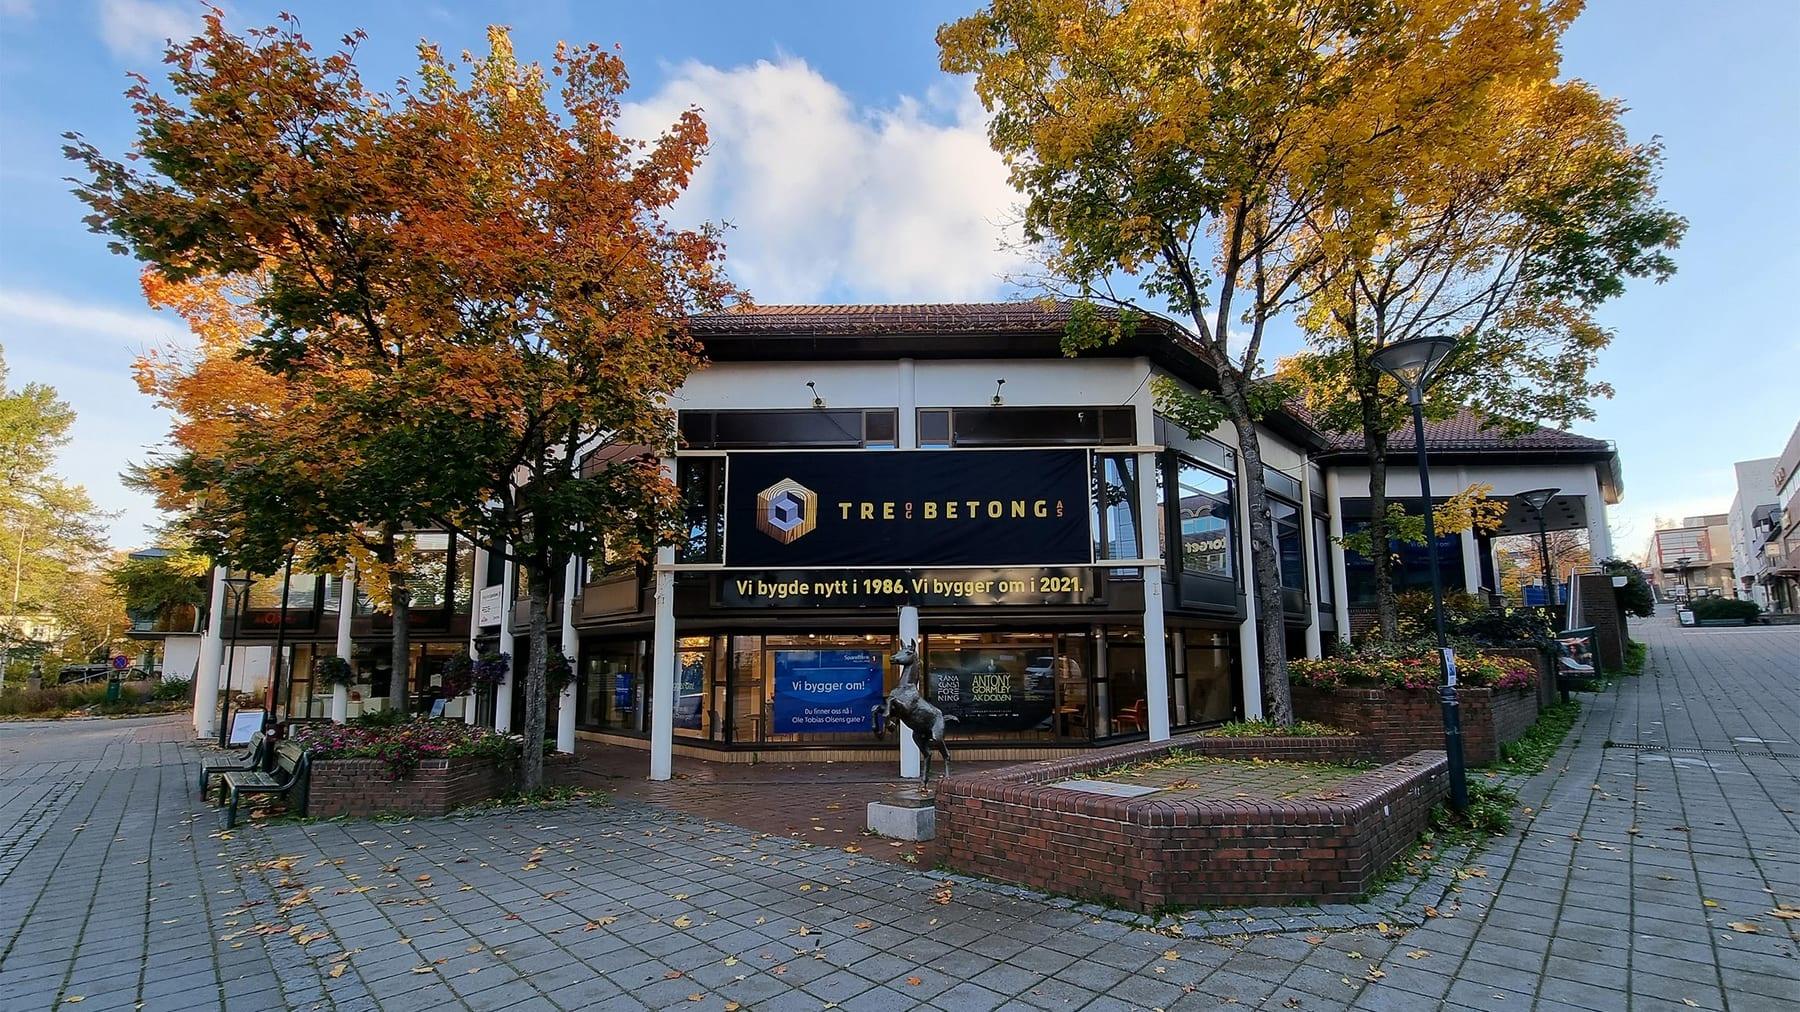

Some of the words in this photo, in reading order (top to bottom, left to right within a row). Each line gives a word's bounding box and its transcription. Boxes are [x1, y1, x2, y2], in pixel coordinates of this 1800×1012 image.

[838, 502, 895, 520] TRE
[905, 502, 913, 519] OG
[924, 500, 1047, 519] BETONG
[1056, 500, 1064, 517] AS
[736, 580, 752, 595] Vi
[757, 580, 810, 599] bygde
[814, 580, 848, 598] nytt
[853, 579, 857, 594] i
[863, 578, 909, 594] 1986.
[912, 578, 928, 593] Vi
[933, 578, 994, 597] bygger
[998, 580, 1025, 593] om
[1030, 577, 1035, 592] i
[1040, 576, 1084, 592] 2021.
[792, 681, 802, 691] Vi
[804, 681, 844, 693] bygger
[845, 681, 865, 690] om!
[972, 674, 1011, 687] ANTONY
